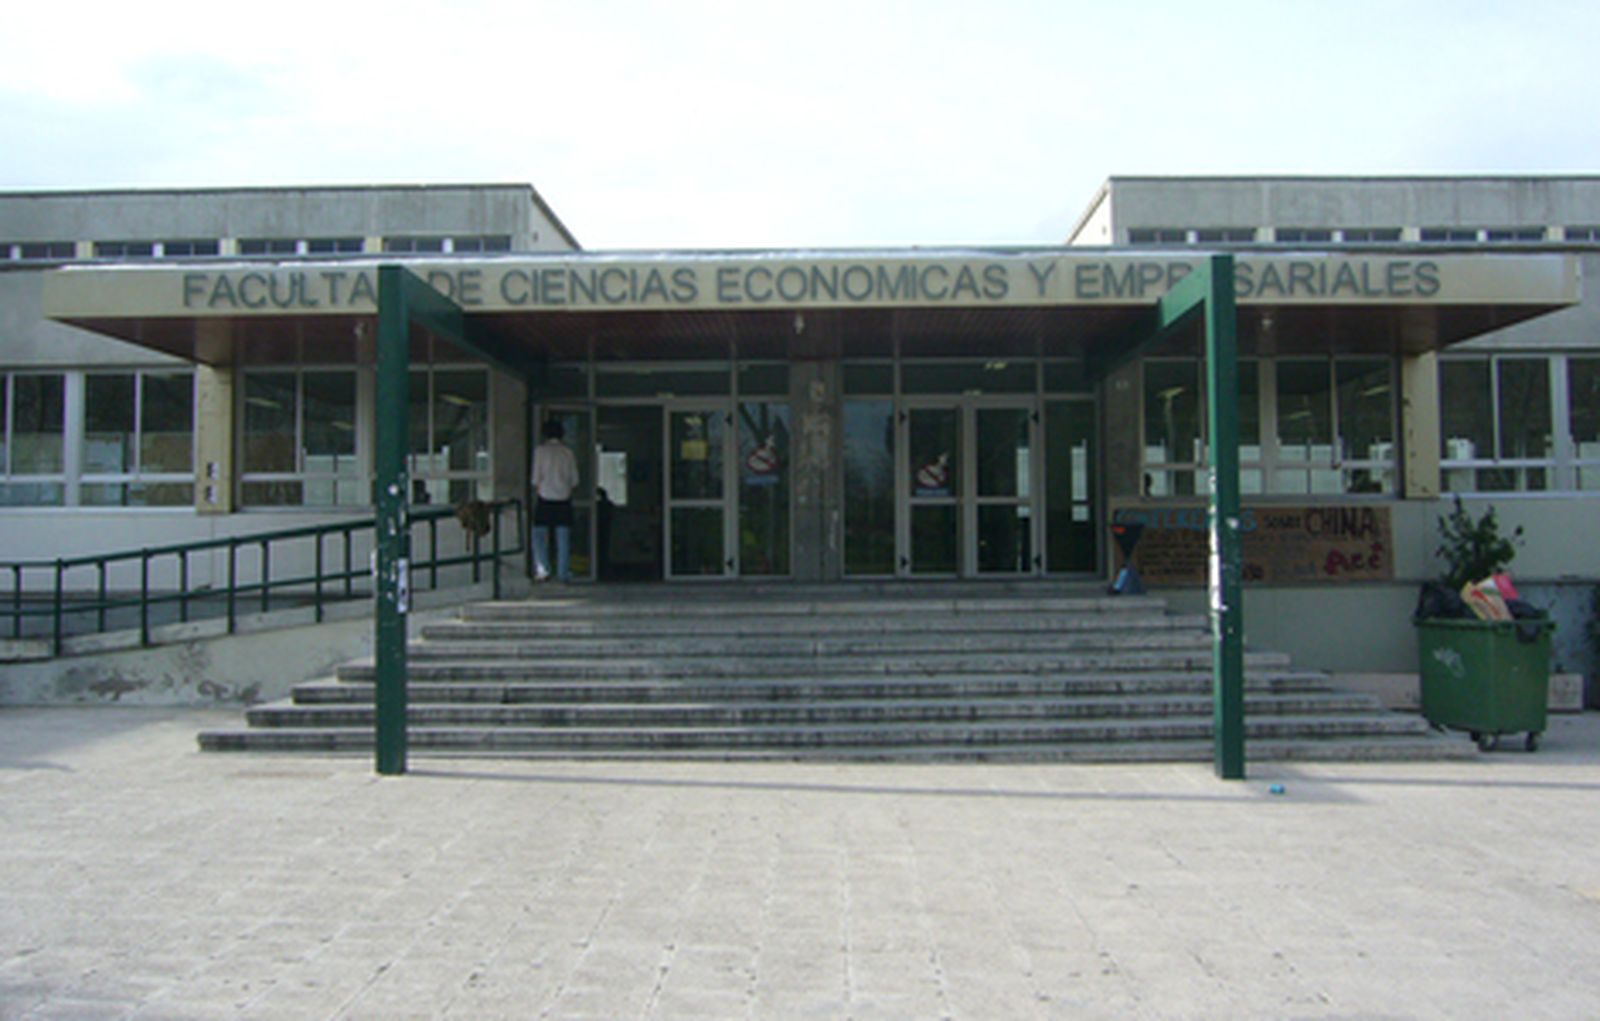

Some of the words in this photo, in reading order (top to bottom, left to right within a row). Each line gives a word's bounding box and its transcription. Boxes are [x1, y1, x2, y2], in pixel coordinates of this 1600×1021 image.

[183, 272, 378, 307] FACULTA
[500, 267, 699, 306] CIENCIAS
[716, 263, 1009, 302] ECONOMICAS
[1028, 262, 1056, 298] Y
[1304, 506, 1378, 536] CHINA
